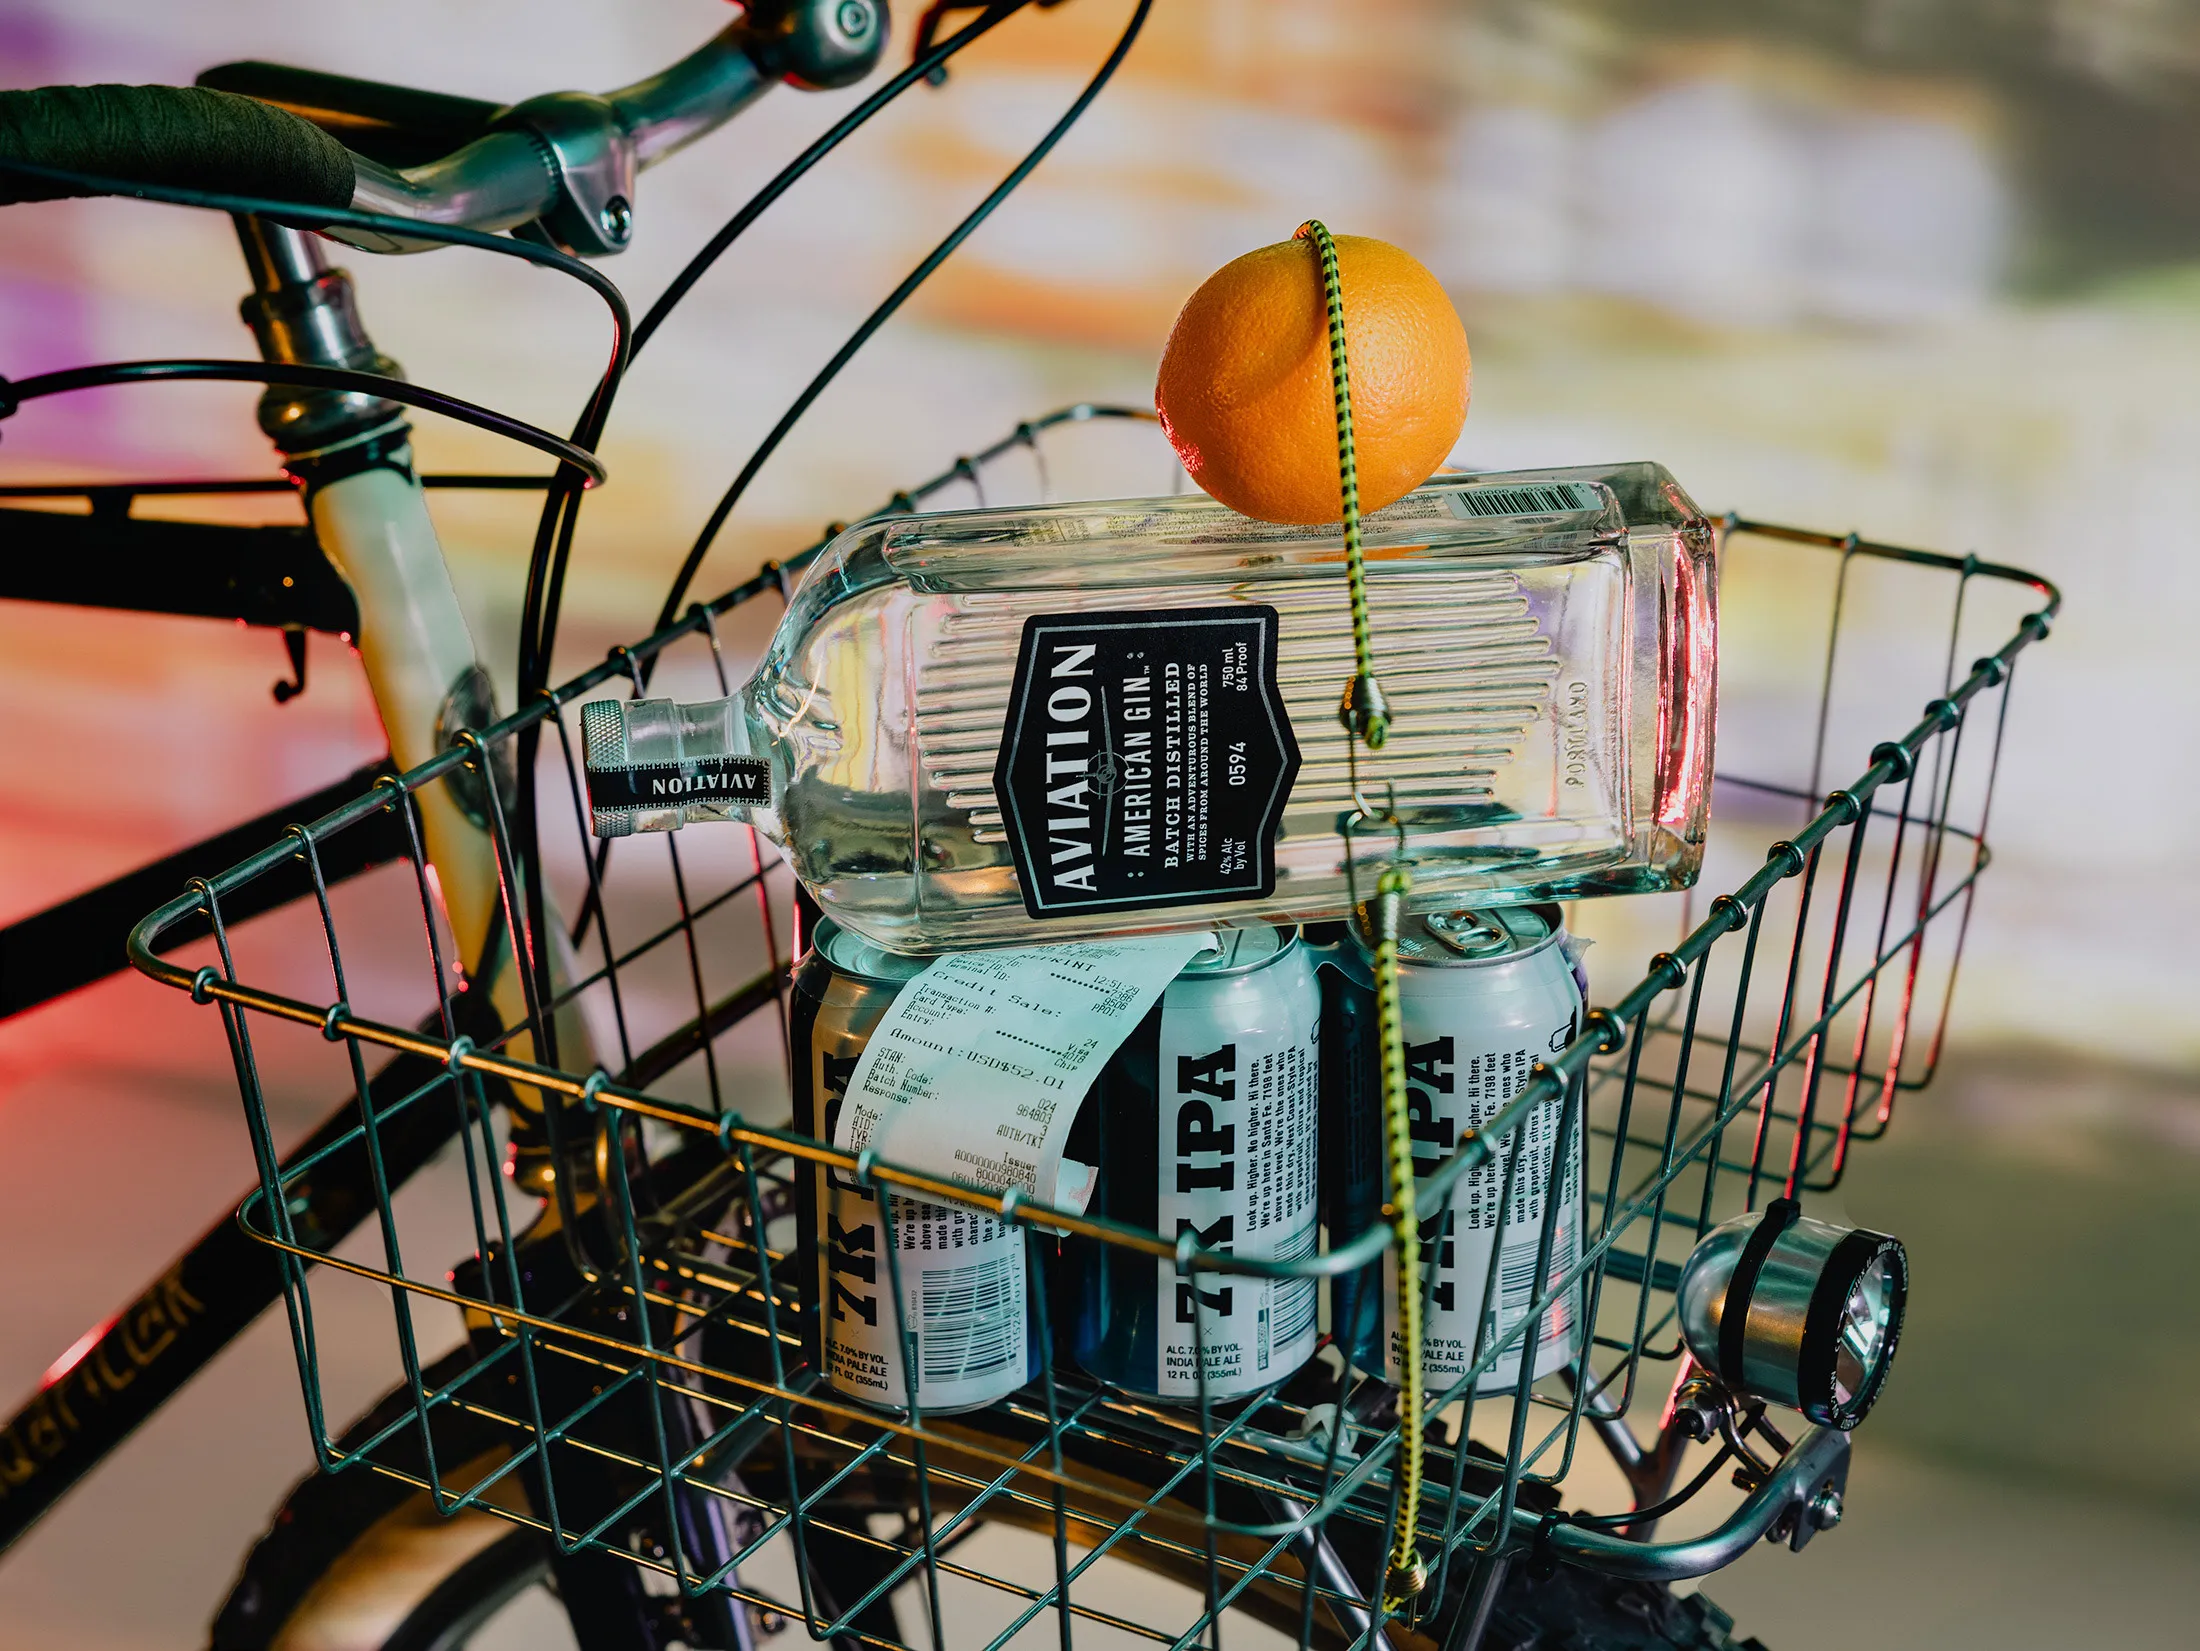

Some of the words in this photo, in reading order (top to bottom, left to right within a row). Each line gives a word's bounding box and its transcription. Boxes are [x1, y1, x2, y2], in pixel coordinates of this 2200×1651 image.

[1222, 648, 1234, 663] ml
[1235, 642, 1247, 674] Proof
[1187, 663, 1196, 679] OF
[1222, 666, 1234, 687] 750
[1200, 664, 1208, 708] WORLD
[1237, 677, 1248, 691] 84
[1188, 683, 1196, 722] BLEND
[1165, 663, 1181, 788] DISTILLED
[1200, 710, 1208, 735] THE
[1046, 644, 1097, 892] AVIATION
[1188, 725, 1197, 812] ADVENTUROUS
[1200, 737, 1208, 786] AROUND
[1229, 742, 1246, 786] 0594
[653, 773, 756, 795] AVIATION
[1124, 732, 1151, 856] AMERICAN
[1199, 789, 1208, 820] FROM
[1165, 796, 1180, 868] BATCH
[1187, 815, 1196, 830] AN
[1187, 833, 1196, 862] WITH
[1199, 823, 1207, 860] SPICES
[1221, 838, 1233, 854] Alc
[1235, 841, 1246, 857] Vol
[1221, 856, 1232, 874] 42%
[1234, 859, 1247, 870] by
[994, 971, 1010, 982] ID:
[1093, 975, 1140, 995] 12:51:29
[913, 992, 939, 1006] Card
[940, 1000, 967, 1015] Type:
[920, 983, 980, 1010] Transaction
[984, 1006, 996, 1015] #:
[933, 970, 996, 997] Credit
[1008, 995, 1062, 1017] Sale:
[1103, 997, 1127, 1010] 9506
[901, 1011, 933, 1026] Entry:
[907, 1002, 951, 1020] Account:
[1068, 1044, 1090, 1057] Visa
[1086, 1039, 1099, 1049] 24
[878, 1047, 906, 1064] STAN:
[1263, 1054, 1272, 1074] feet
[1277, 1051, 1285, 1071] who
[1288, 1046, 1296, 1063] IPA
[1484, 1053, 1496, 1072] feet
[1501, 1053, 1511, 1073] who
[1516, 1049, 1526, 1066] IPA
[873, 1059, 899, 1075] Auth.
[905, 1069, 934, 1085] Code:
[1054, 1059, 1079, 1072] Chip
[1248, 1059, 1259, 1088] there.
[1297, 1048, 1306, 1085] tropical
[1469, 1056, 1480, 1083] there.
[862, 1080, 914, 1105] Response:
[867, 1070, 896, 1087] Batch
[900, 1082, 939, 1100] Number:
[1263, 1076, 1272, 1100] 7198
[1277, 1075, 1285, 1097] ones
[1468, 1088, 1480, 1097] Hi
[1485, 1075, 1496, 1099] 7198
[1503, 1076, 1511, 1098] ones
[1038, 1098, 1058, 1113] 024
[1248, 1090, 1258, 1101] Hi
[855, 1103, 884, 1121] Mode:
[1016, 1105, 1053, 1125] 964803
[1176, 1042, 1236, 1194] IPA
[1262, 1102, 1272, 1116] Fe.
[1275, 1101, 1284, 1115] the
[1484, 1101, 1496, 1116] Fe.
[852, 1116, 875, 1130] AID:
[1248, 1103, 1260, 1137] higher.
[1530, 1116, 1538, 1143] citrus
[851, 1128, 872, 1142] TVR:
[996, 1124, 1044, 1149] AUTH/TKT
[1041, 1125, 1048, 1136] 3
[1262, 1119, 1272, 1147] Santa
[1275, 1118, 1284, 1146] We're
[1287, 1124, 1295, 1147] West
[1542, 1124, 1551, 1139] It's
[1248, 1140, 1258, 1152] No
[1262, 1150, 1271, 1159] in
[1003, 1151, 1037, 1173] Issuer
[1274, 1148, 1284, 1174] level.
[1516, 1155, 1528, 1173] dry,
[1530, 1146, 1540, 1195] grapefruit,
[1247, 1155, 1259, 1189] Higher.
[1262, 1162, 1271, 1182] here
[1286, 1172, 1294, 1189] this
[1484, 1163, 1496, 1183] here
[1263, 1185, 1272, 1198] up
[1486, 1187, 1498, 1198] up
[1515, 1177, 1526, 1195] this
[1249, 1191, 1259, 1206] up.
[1470, 1190, 1483, 1204] up.
[904, 1209, 917, 1220] up
[921, 1204, 931, 1220] sea
[1260, 1201, 1270, 1228] We're
[1274, 1196, 1283, 1223] above
[1468, 1208, 1480, 1230] Look
[1485, 1202, 1496, 1228] We're
[1516, 1198, 1525, 1223] made
[1530, 1199, 1538, 1219] with
[1246, 1209, 1257, 1232] Look
[903, 1224, 915, 1250] We're
[920, 1224, 931, 1250] above
[937, 1225, 948, 1249] made
[953, 1227, 964, 1248] with
[982, 1227, 993, 1242] the
[828, 1212, 877, 1327] 7K
[1175, 1214, 1234, 1324] 7K
[1167, 1346, 1186, 1354] ALC.
[1211, 1345, 1223, 1353] BY
[1224, 1343, 1243, 1352] VOL.
[1433, 1339, 1446, 1347] BY
[1447, 1340, 1466, 1348] VOL.
[858, 1351, 869, 1360] BY
[870, 1353, 889, 1364] VOL.
[1167, 1357, 1193, 1367] INDIA
[1223, 1354, 1240, 1365] ALE
[1392, 1356, 1400, 1365] 12
[1429, 1364, 1465, 1374] (355mL)
[1446, 1352, 1464, 1361] ALE
[847, 1358, 868, 1373] PALE
[870, 1365, 887, 1377] ALE
[1167, 1370, 1177, 1379] 12
[1180, 1371, 1190, 1379] FL
[1207, 1368, 1242, 1380] (355mL)
[844, 1371, 854, 1381] OZ
[856, 1375, 888, 1390] (355mL)
